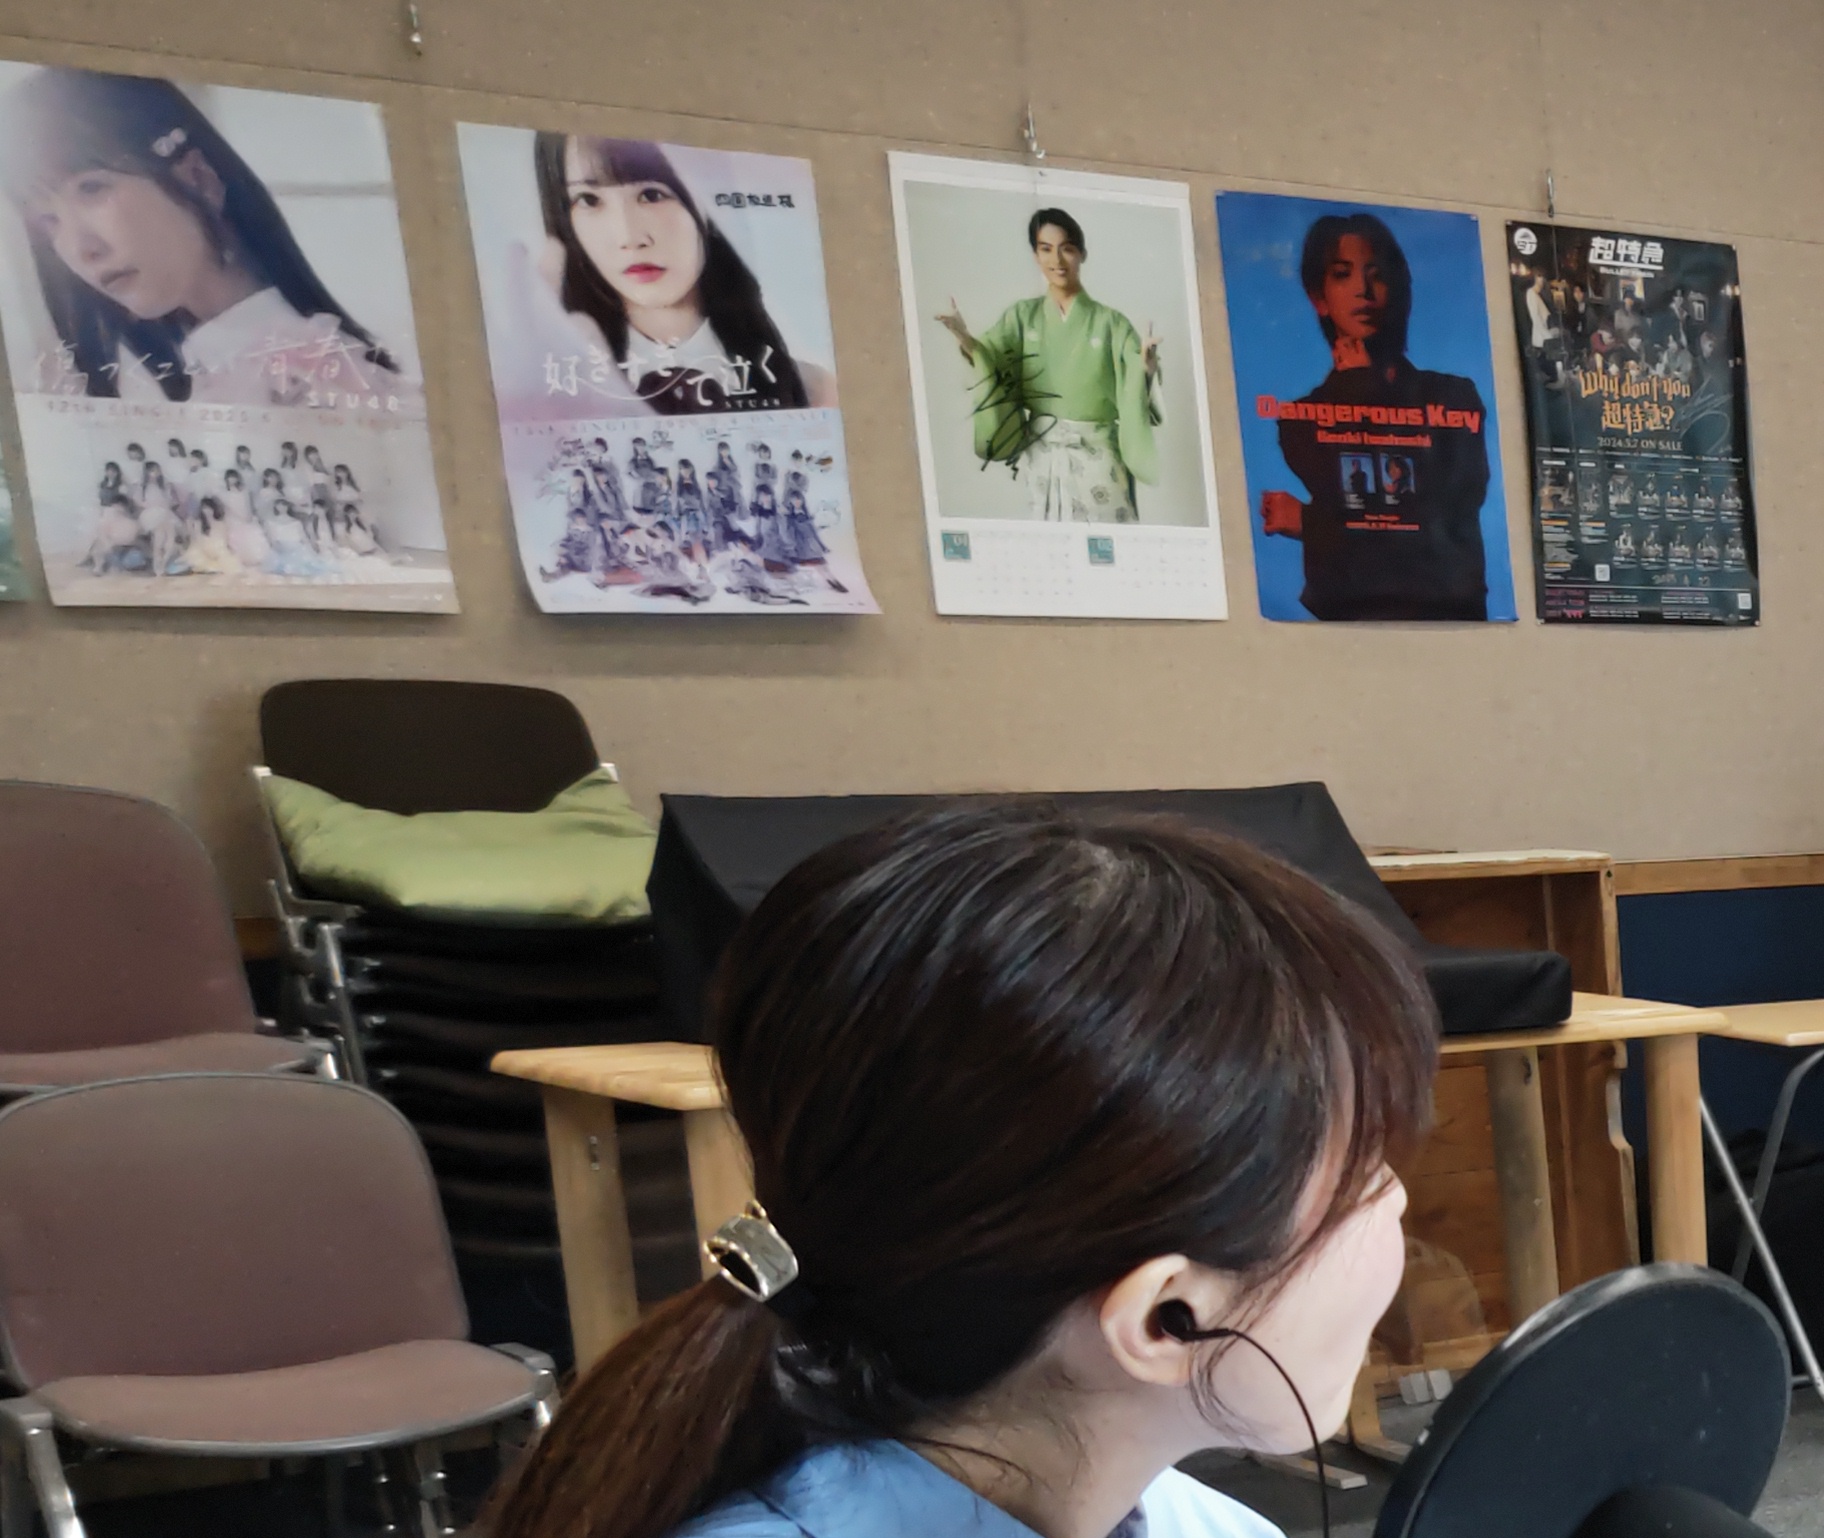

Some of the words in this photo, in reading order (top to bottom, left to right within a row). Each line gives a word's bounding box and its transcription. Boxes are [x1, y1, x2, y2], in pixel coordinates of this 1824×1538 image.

[1589, 237, 1664, 270] 超特急
[308, 395, 401, 411] STU48
[1255, 394, 1426, 428] Dangerous
[1426, 404, 1481, 434] Key
